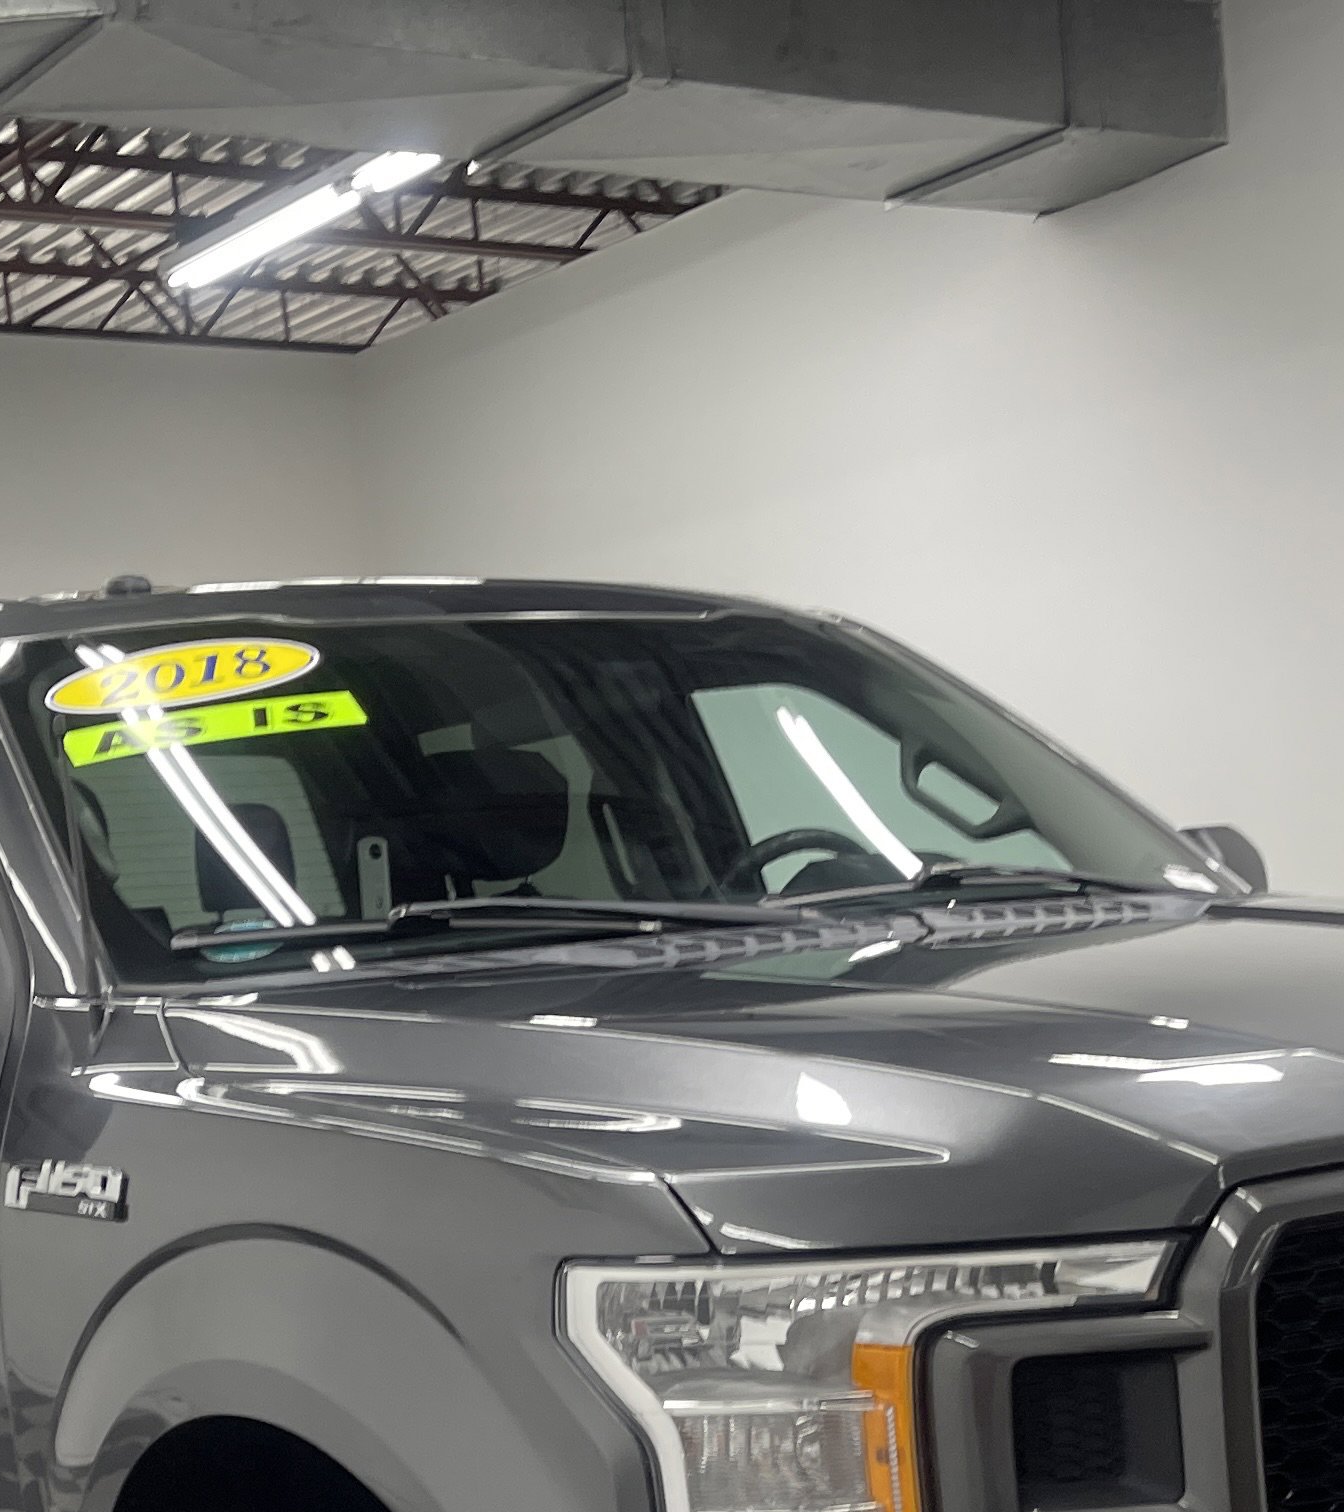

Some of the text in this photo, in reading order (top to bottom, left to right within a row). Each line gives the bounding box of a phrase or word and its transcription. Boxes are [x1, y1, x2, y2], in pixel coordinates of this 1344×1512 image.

[99, 645, 272, 706] 2018
[93, 702, 329, 756] AS IS
